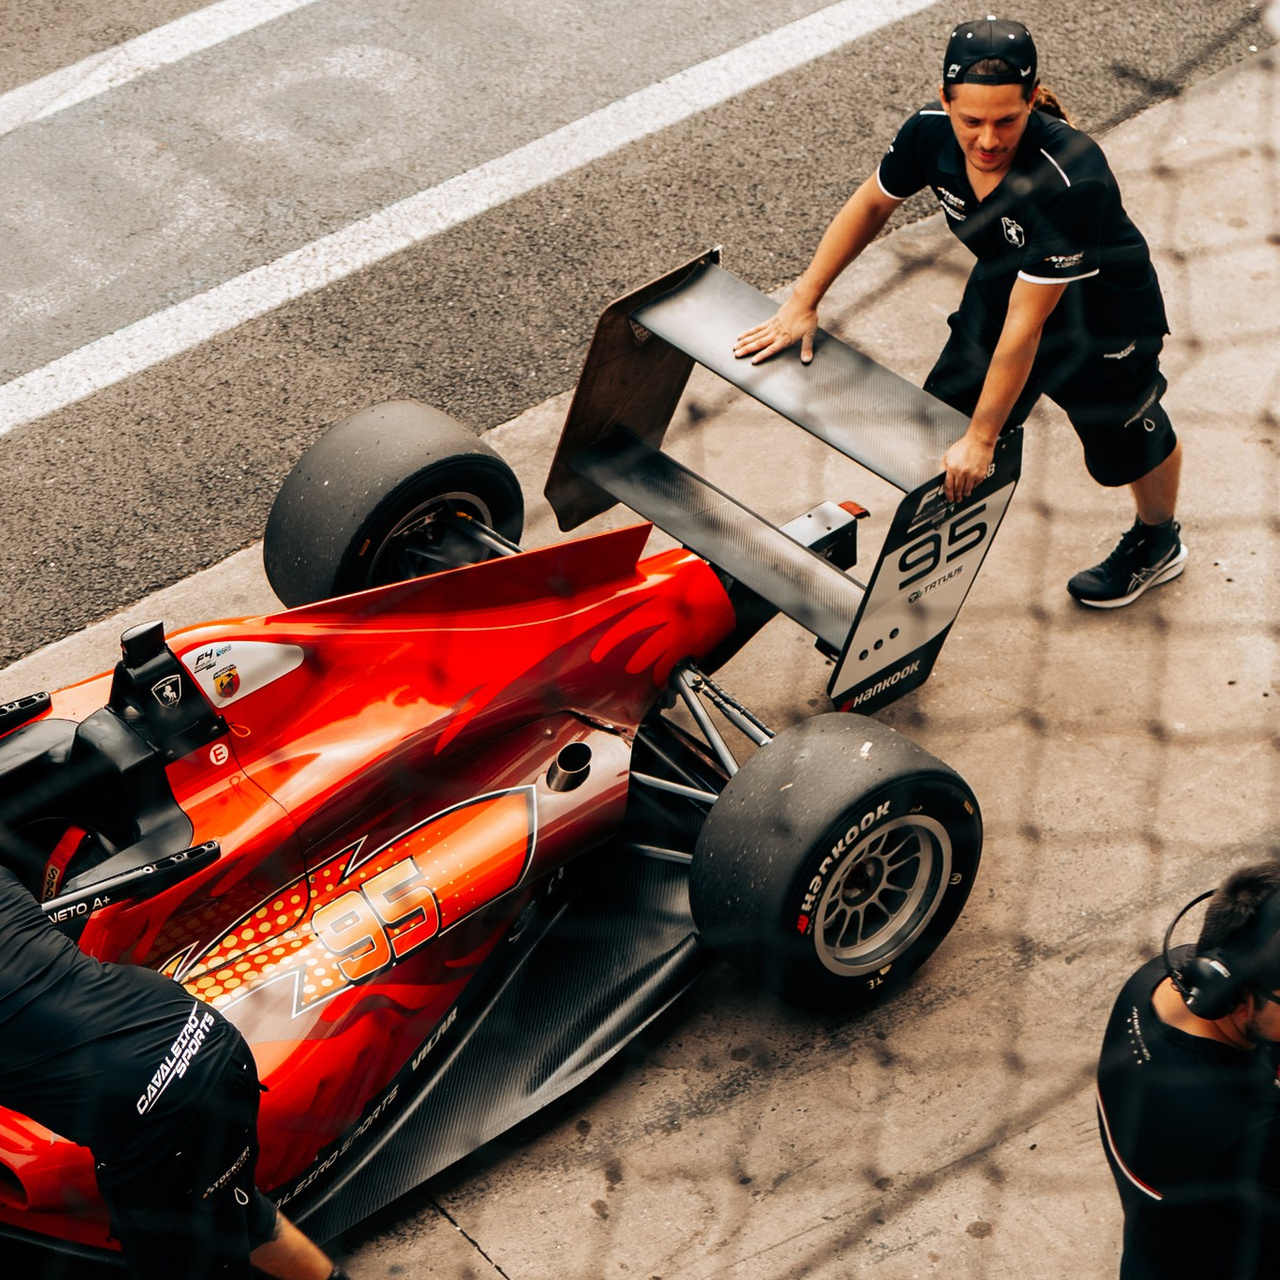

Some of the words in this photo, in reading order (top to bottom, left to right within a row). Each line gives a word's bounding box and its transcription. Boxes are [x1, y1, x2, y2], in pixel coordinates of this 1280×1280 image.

[898, 503, 987, 591] 95
[195, 649, 213, 665] F4
[213, 746, 226, 763] E
[45, 868, 58, 898] Sab
[92, 896, 110, 909] A+
[312, 856, 439, 981] 95
[175, 1012, 214, 1079] SPORTS
[412, 1006, 458, 1071] VICAR
[274, 1150, 339, 1210] ALEIRO
[339, 1084, 399, 1156] SPORTS
